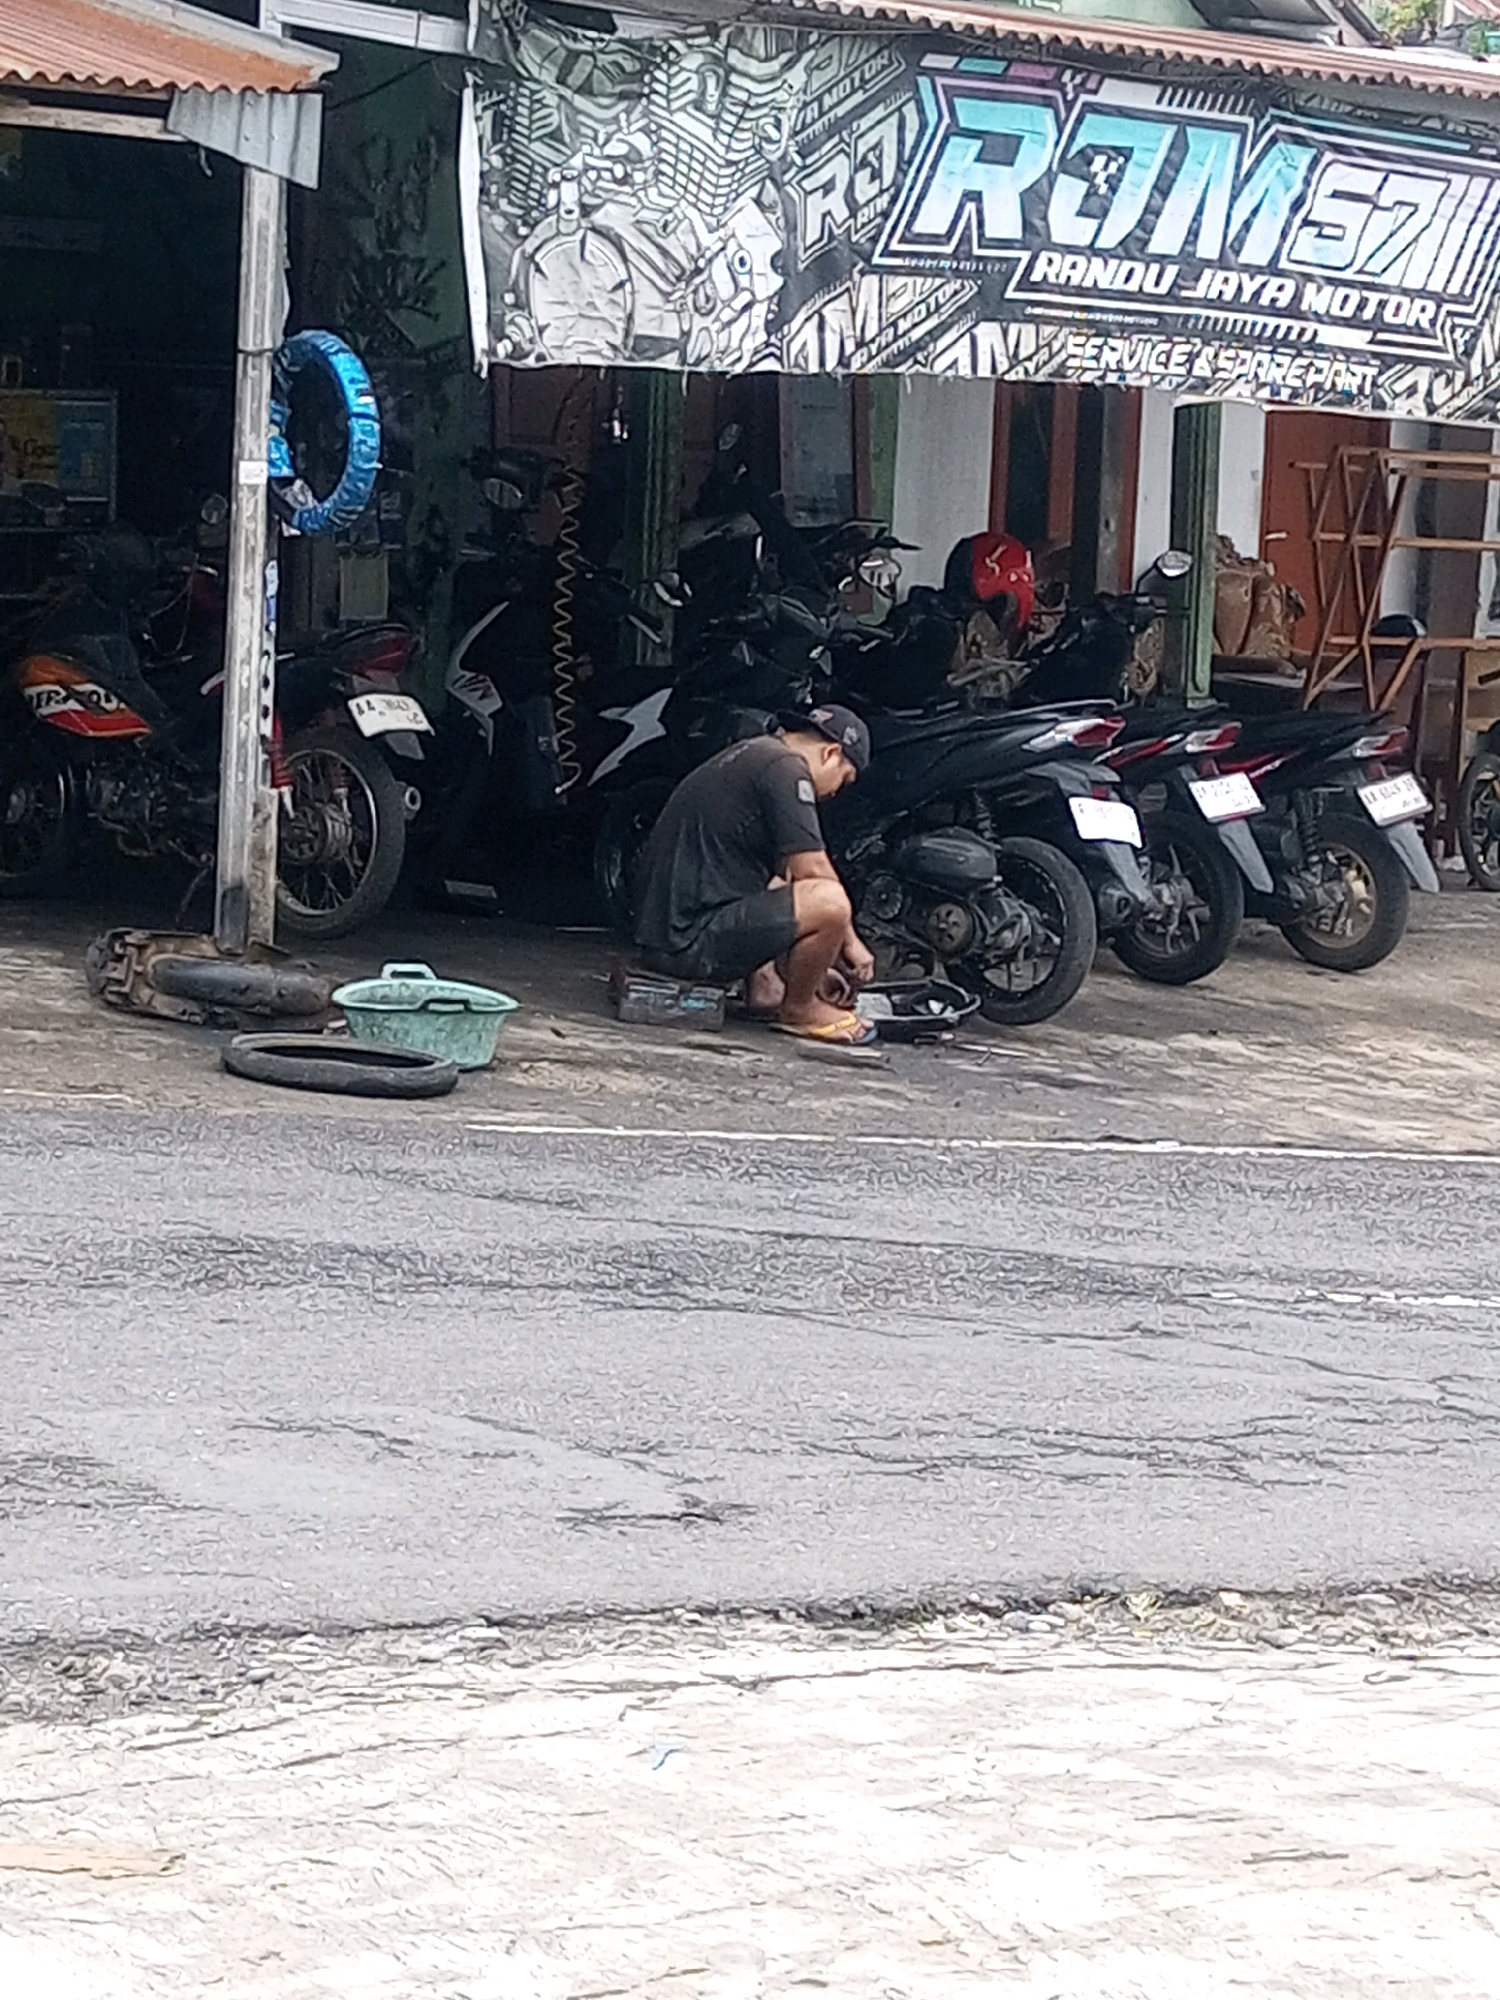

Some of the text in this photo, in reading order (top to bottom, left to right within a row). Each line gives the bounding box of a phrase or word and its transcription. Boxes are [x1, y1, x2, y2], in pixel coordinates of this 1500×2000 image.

[1030, 250, 1180, 296] RANDU
[1179, 267, 1297, 309] JAYA
[1301, 281, 1438, 329] MOTOR
[1065, 334, 1195, 377] SERVICE
